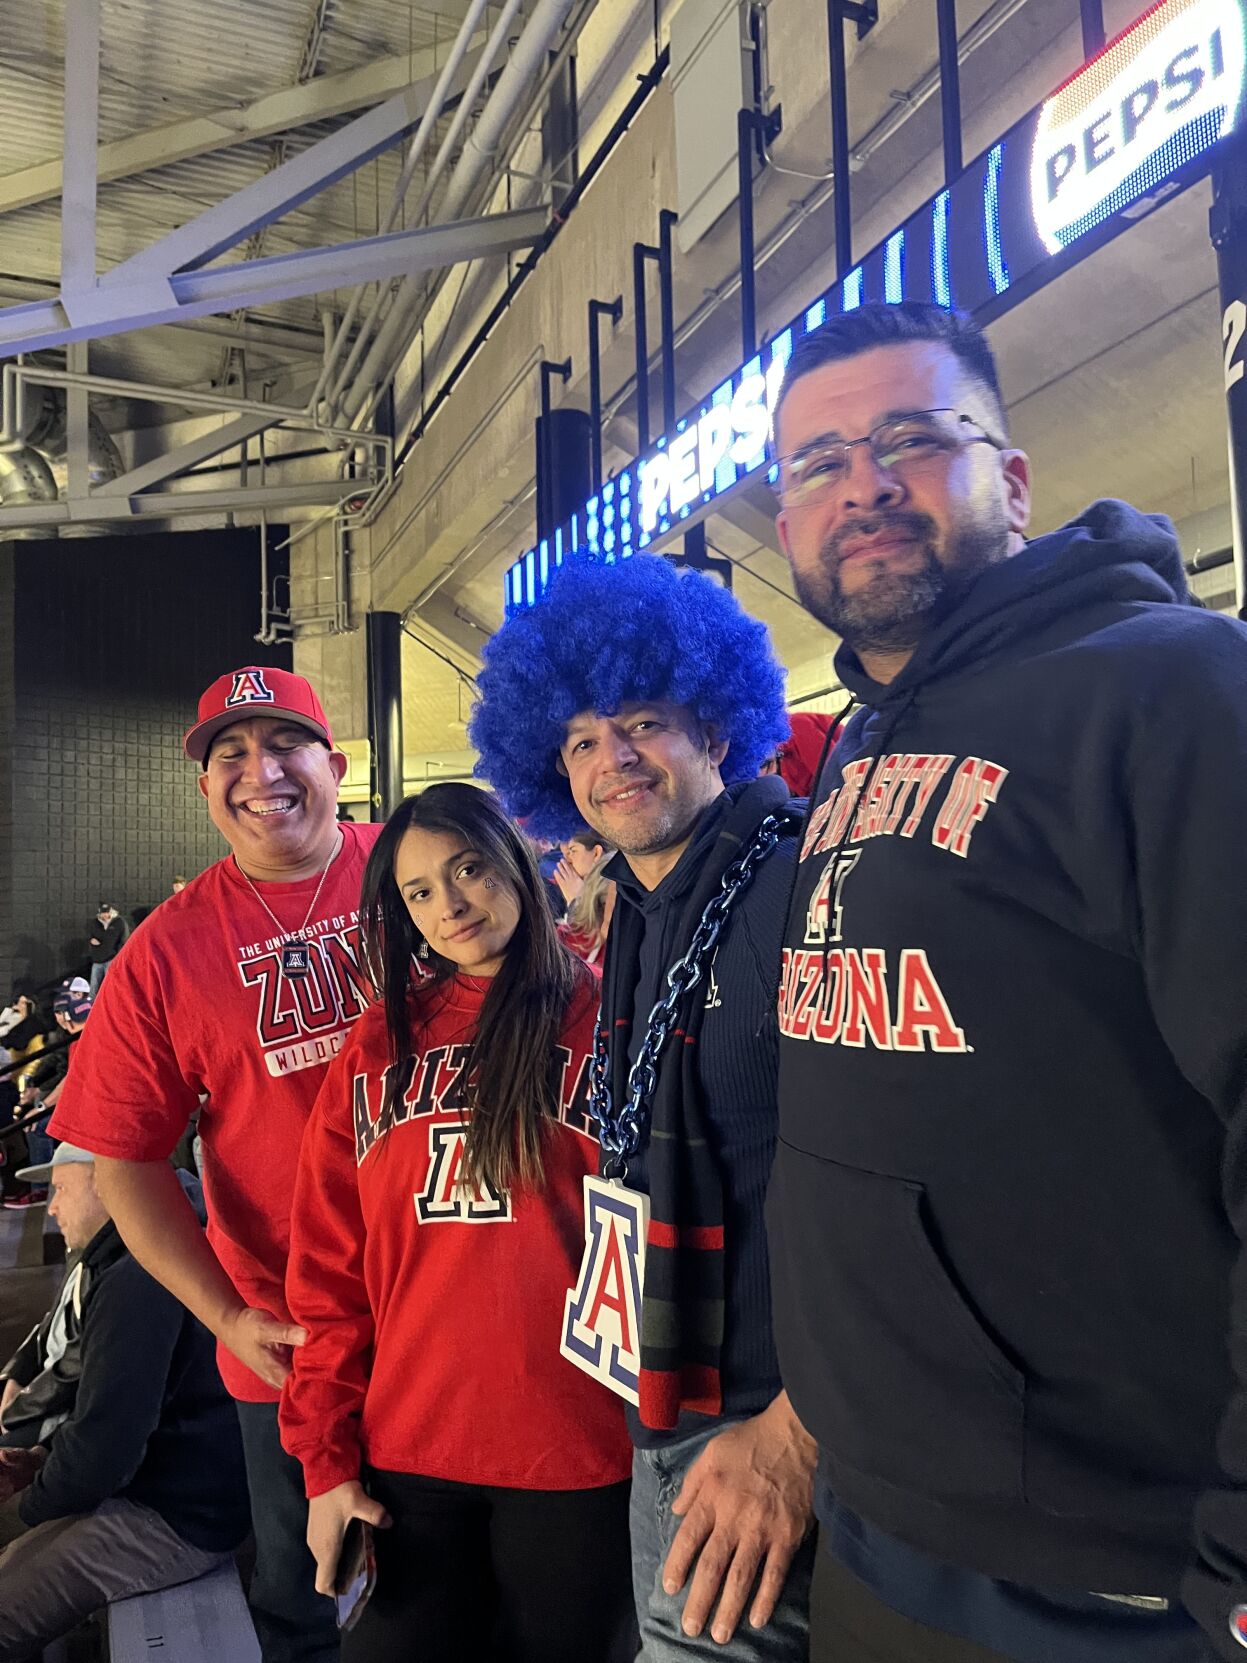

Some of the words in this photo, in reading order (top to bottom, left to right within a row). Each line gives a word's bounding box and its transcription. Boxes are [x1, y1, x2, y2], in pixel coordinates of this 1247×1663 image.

[1045, 26, 1225, 204] PEPSI
[1222, 299, 1247, 392] 2
[225, 669, 275, 709] A
[931, 755, 1010, 859] OF
[239, 942, 264, 960] THE
[264, 918, 330, 952] UNIVERSITY
[331, 914, 347, 930] OF
[286, 951, 305, 968] A
[776, 946, 968, 1053] RIZONA
[560, 1180, 643, 1402] A
